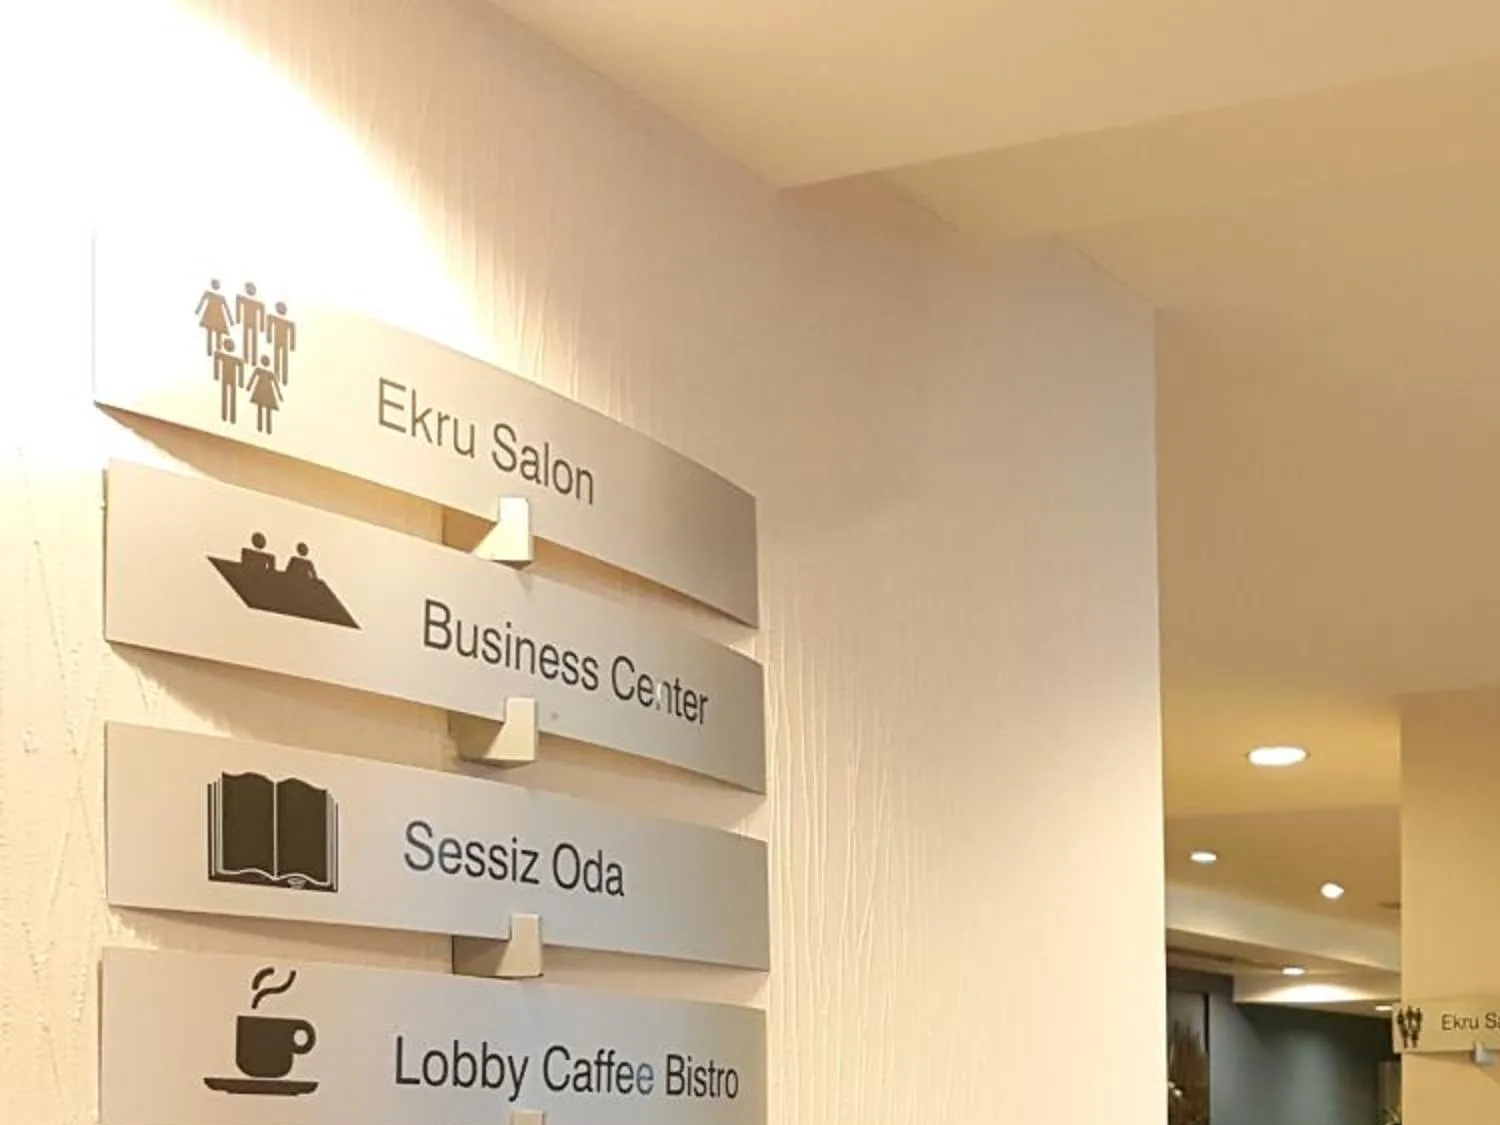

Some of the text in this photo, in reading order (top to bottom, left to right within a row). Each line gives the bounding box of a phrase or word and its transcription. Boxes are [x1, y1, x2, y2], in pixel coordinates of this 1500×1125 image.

[378, 376, 594, 505] Ekru Salon
[423, 598, 709, 725] Business Center
[403, 820, 625, 897] Sessiz Oda
[1440, 1012, 1480, 1031] Ekru
[395, 1035, 740, 1102] Lobby Caffee Bistro
